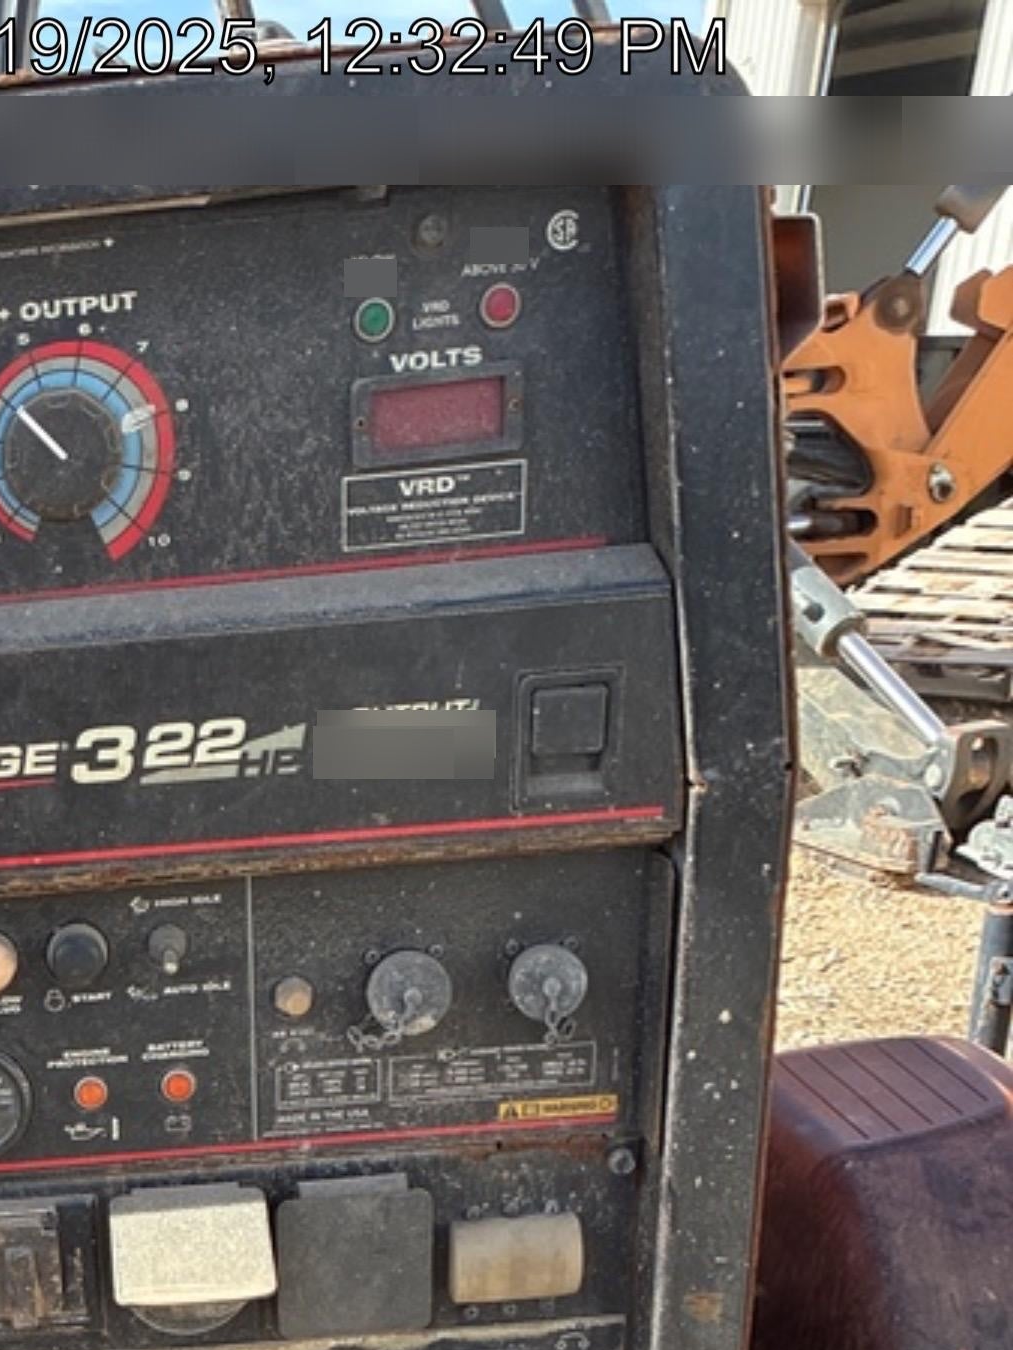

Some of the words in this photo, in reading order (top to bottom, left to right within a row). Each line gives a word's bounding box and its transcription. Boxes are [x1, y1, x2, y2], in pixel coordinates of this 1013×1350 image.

[19, 291, 138, 322] OUTPUT
[390, 345, 483, 373] VOLTS
[399, 476, 456, 498] VRD
[70, 716, 248, 785] 322
